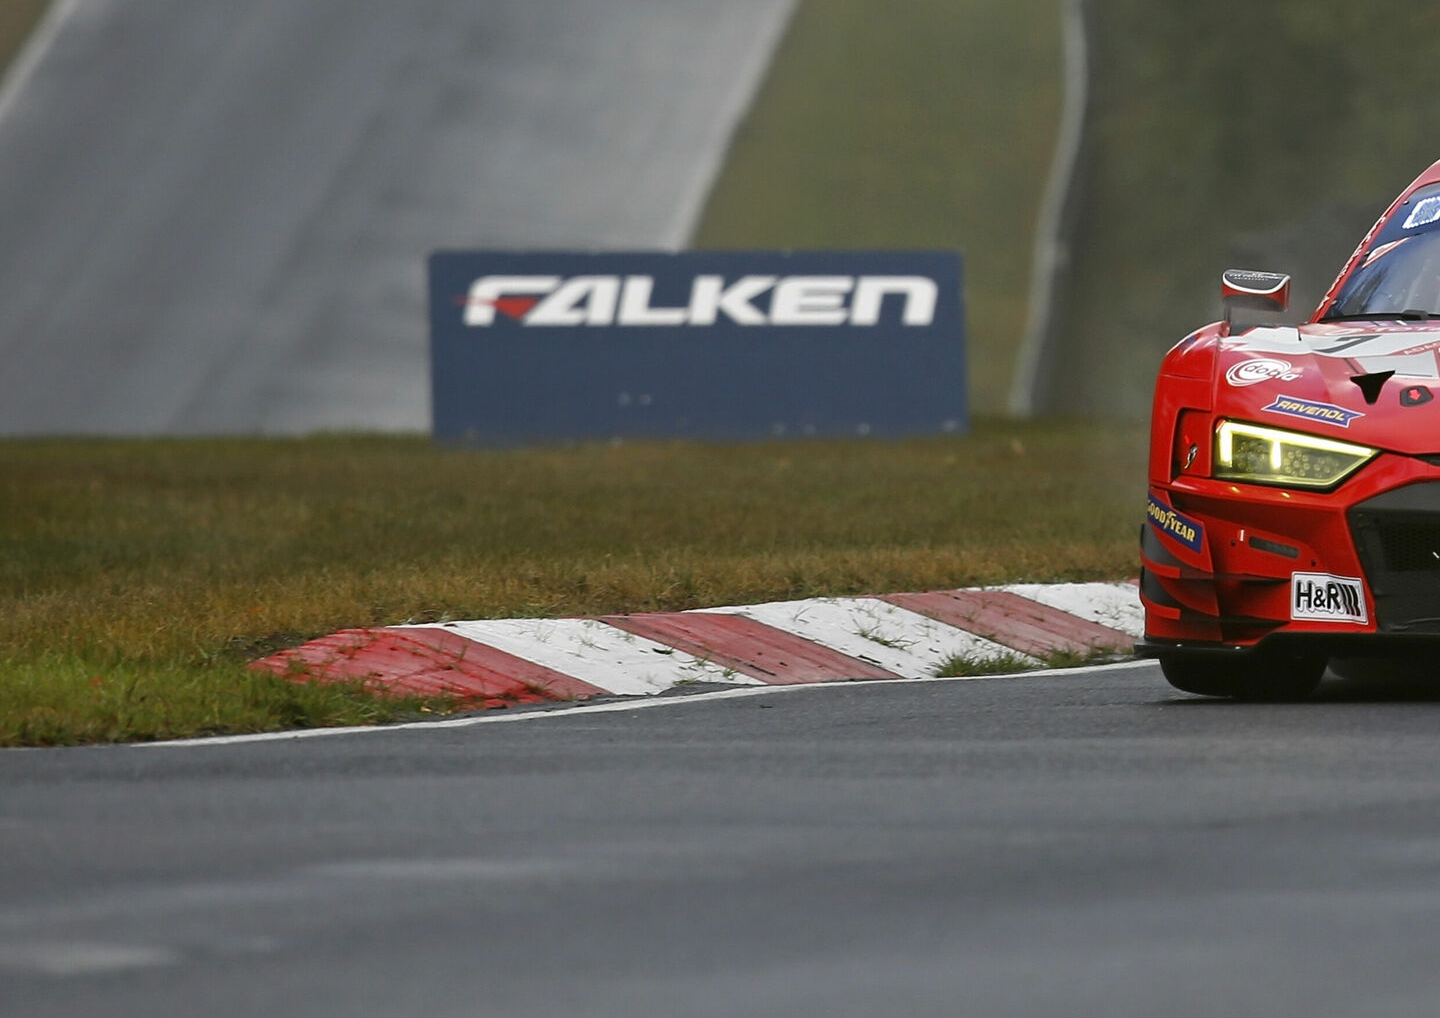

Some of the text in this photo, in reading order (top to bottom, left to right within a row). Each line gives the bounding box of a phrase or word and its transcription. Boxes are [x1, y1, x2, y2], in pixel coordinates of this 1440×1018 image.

[463, 275, 939, 327] FALKEN
[1277, 400, 1346, 421] RAVENOL
[1295, 581, 1343, 612] H&R
